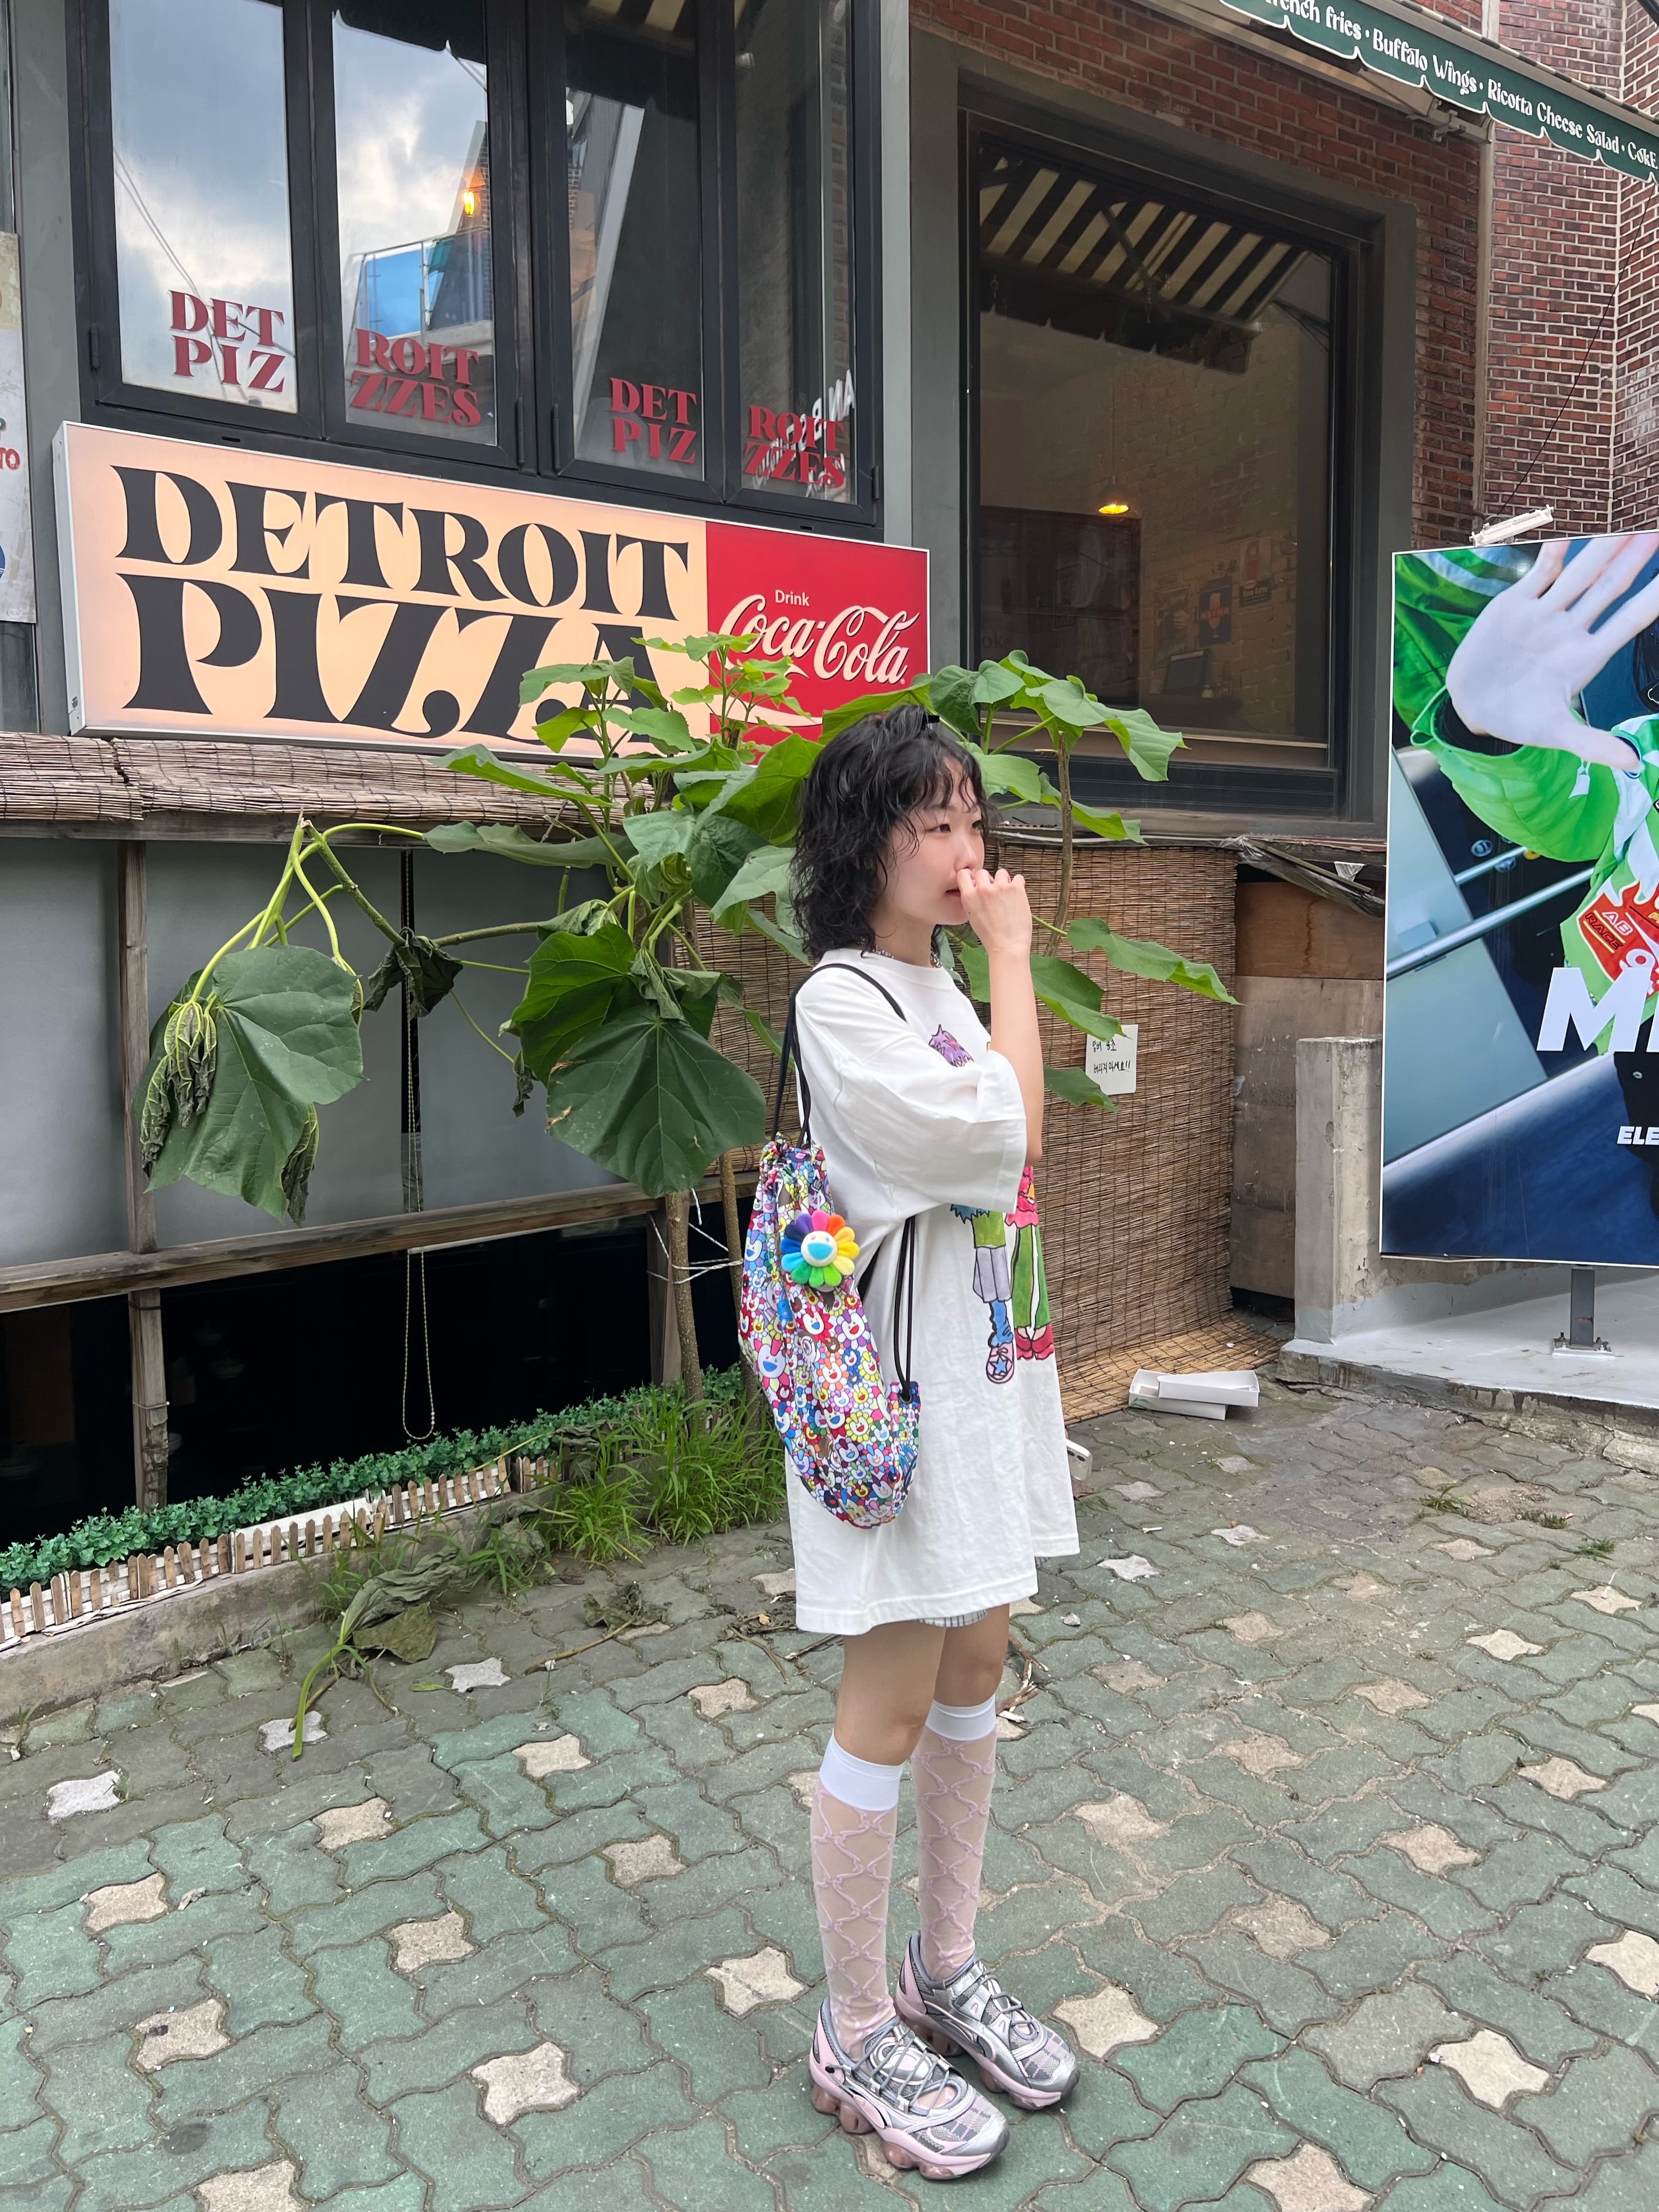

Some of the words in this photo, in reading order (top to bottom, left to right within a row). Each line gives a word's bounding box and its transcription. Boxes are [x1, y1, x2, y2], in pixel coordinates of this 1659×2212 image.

[1326, 5, 1362, 40] fries
[1373, 28, 1427, 71] Buffalo
[1433, 54, 1477, 95] Wings
[1488, 78, 1532, 116] Ricotta
[1537, 102, 1583, 138] Cheese
[1587, 124, 1620, 154] Salad
[170, 290, 284, 347] DET
[172, 335, 285, 393] PIZ
[357, 328, 479, 386] ROIT
[350, 370, 479, 427] ZZES
[610, 378, 697, 425] DET
[612, 416, 697, 464] PIZ
[749, 405, 844, 452] ROIT
[744, 441, 845, 489] ZZES
[110, 465, 689, 621] DETROIT
[775, 589, 810, 606] Drink
[116, 572, 686, 745] PIZZA
[716, 594, 920, 684] Coca-Cola
[1585, 912, 1623, 949] RACE
[1602, 911, 1633, 936] AB
[1536, 967, 1659, 1052] M
